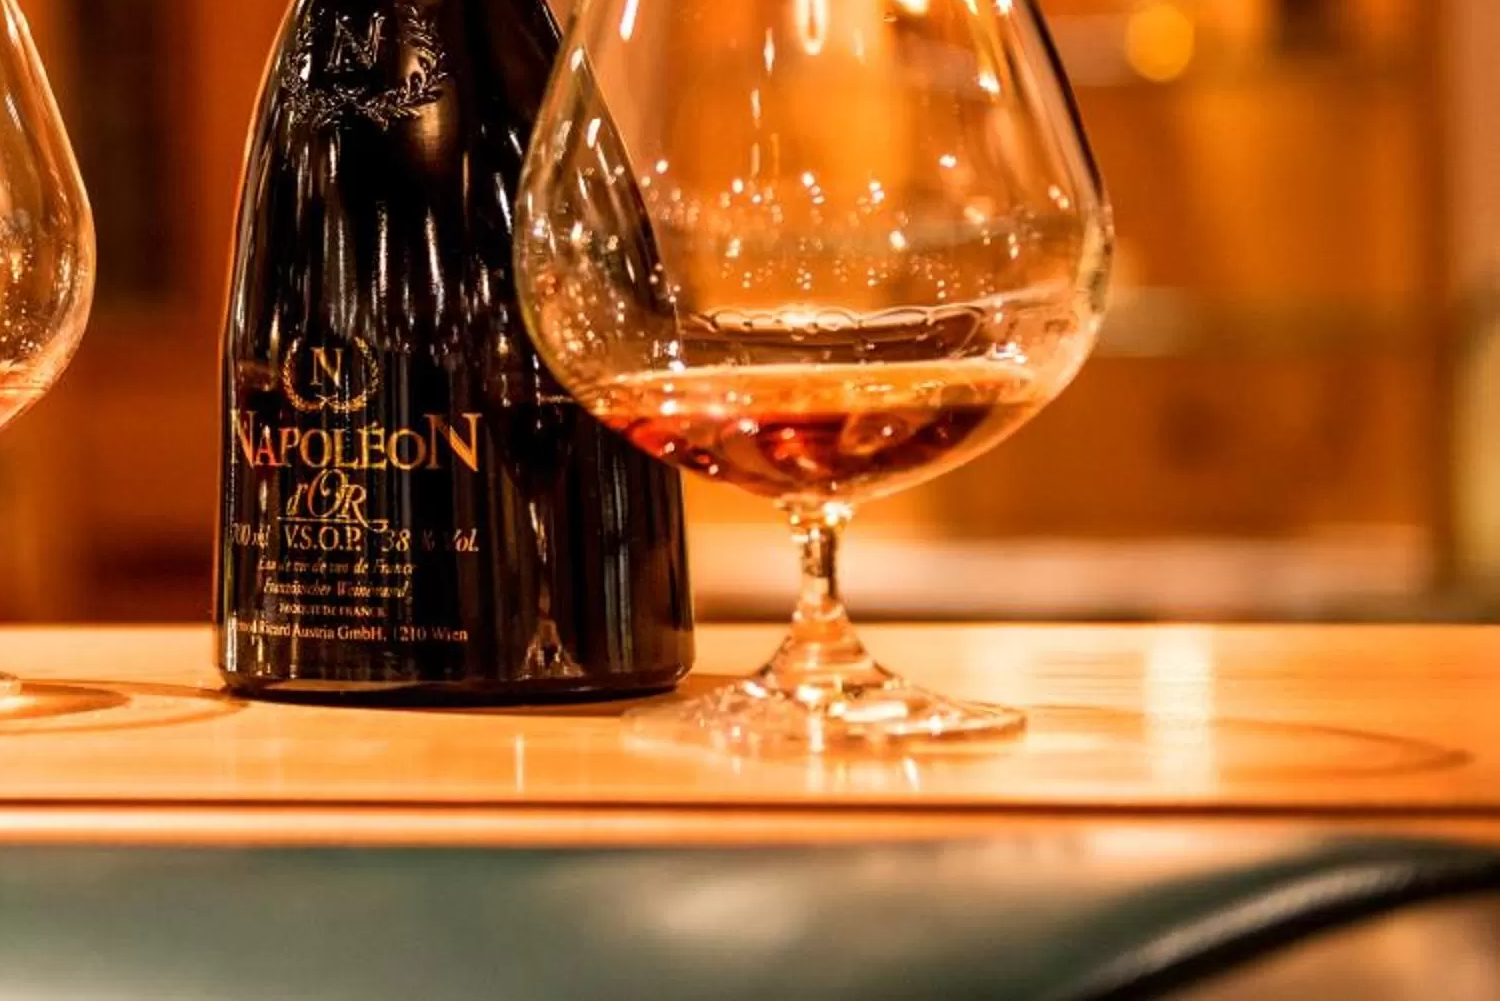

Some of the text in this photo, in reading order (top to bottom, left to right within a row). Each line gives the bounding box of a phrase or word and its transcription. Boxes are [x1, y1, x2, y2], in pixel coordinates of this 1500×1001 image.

[309, 346, 342, 388] N
[284, 523, 362, 551] V.S.O.P.
[291, 622, 335, 639] Austria
